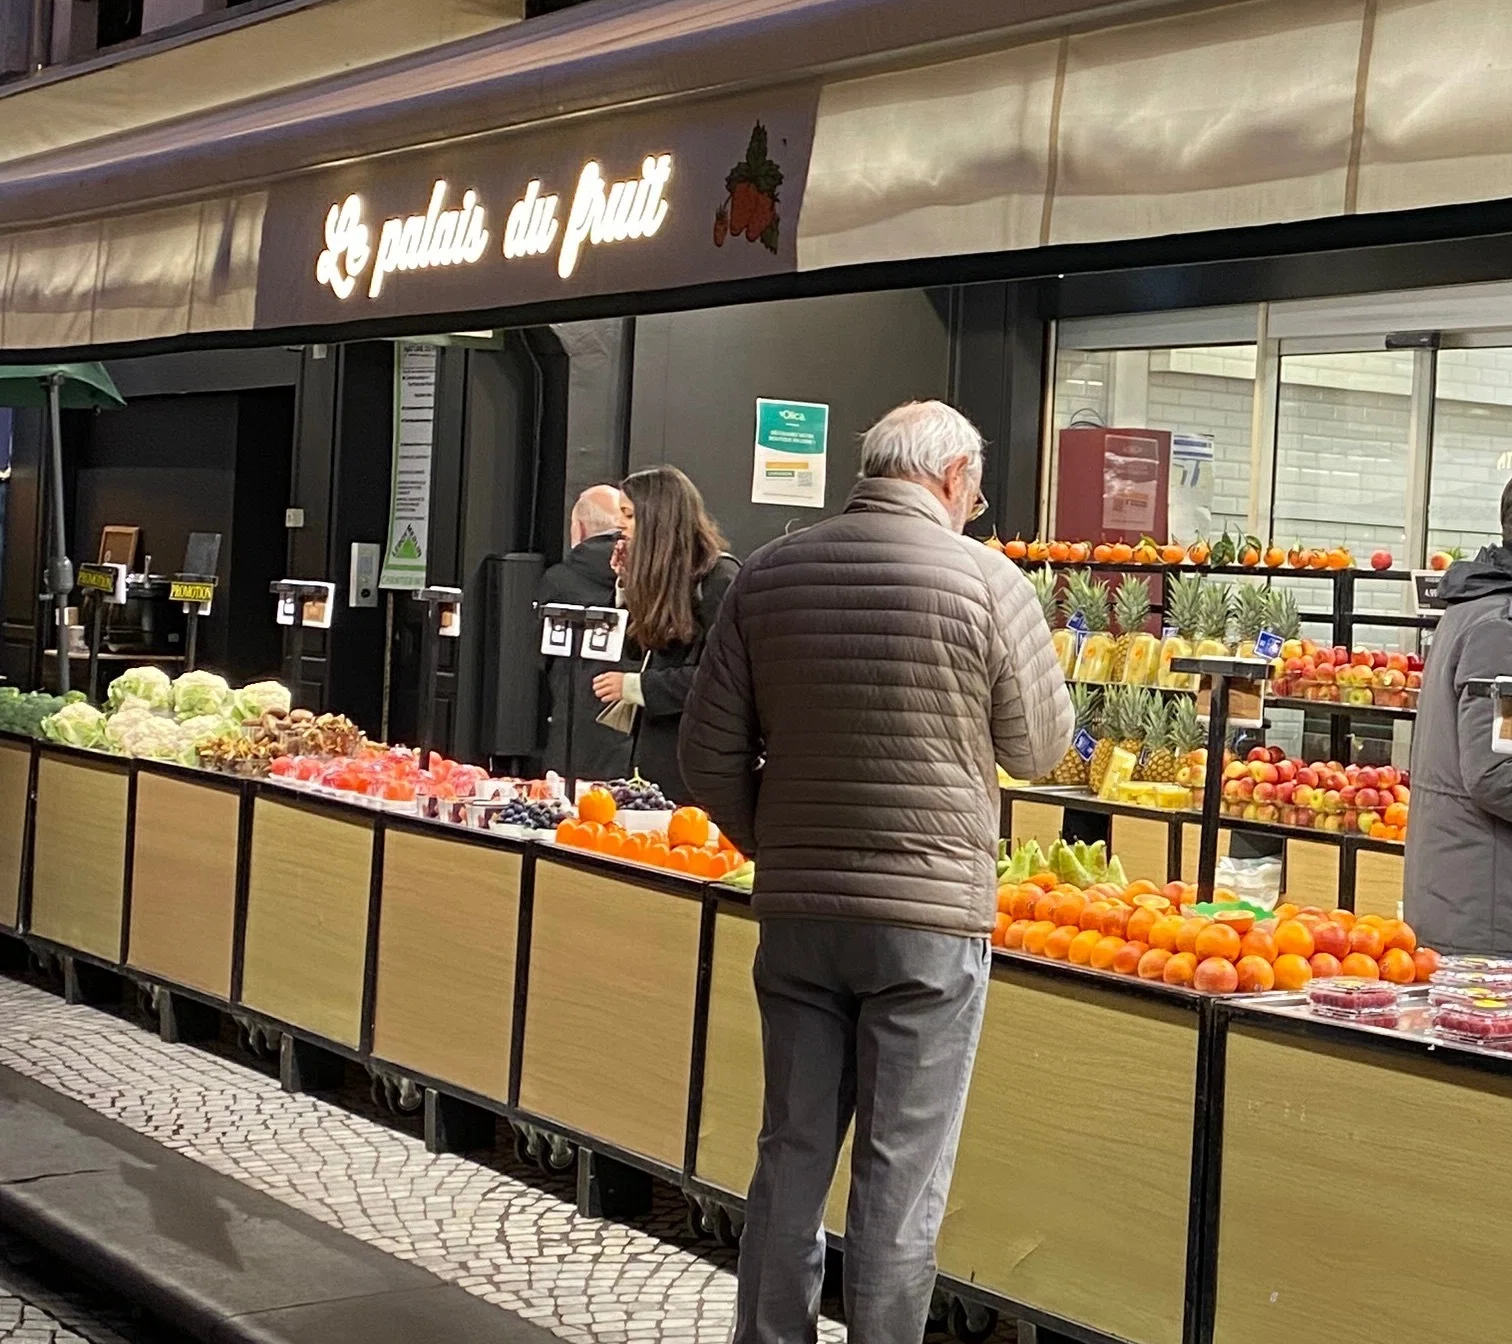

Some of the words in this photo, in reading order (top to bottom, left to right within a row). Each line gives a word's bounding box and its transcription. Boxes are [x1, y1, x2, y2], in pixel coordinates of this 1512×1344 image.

[316, 193, 370, 299] Le
[368, 178, 489, 299] palais
[502, 178, 560, 259] du
[557, 153, 673, 280] fruit
[172, 583, 211, 600] PROMOTION
